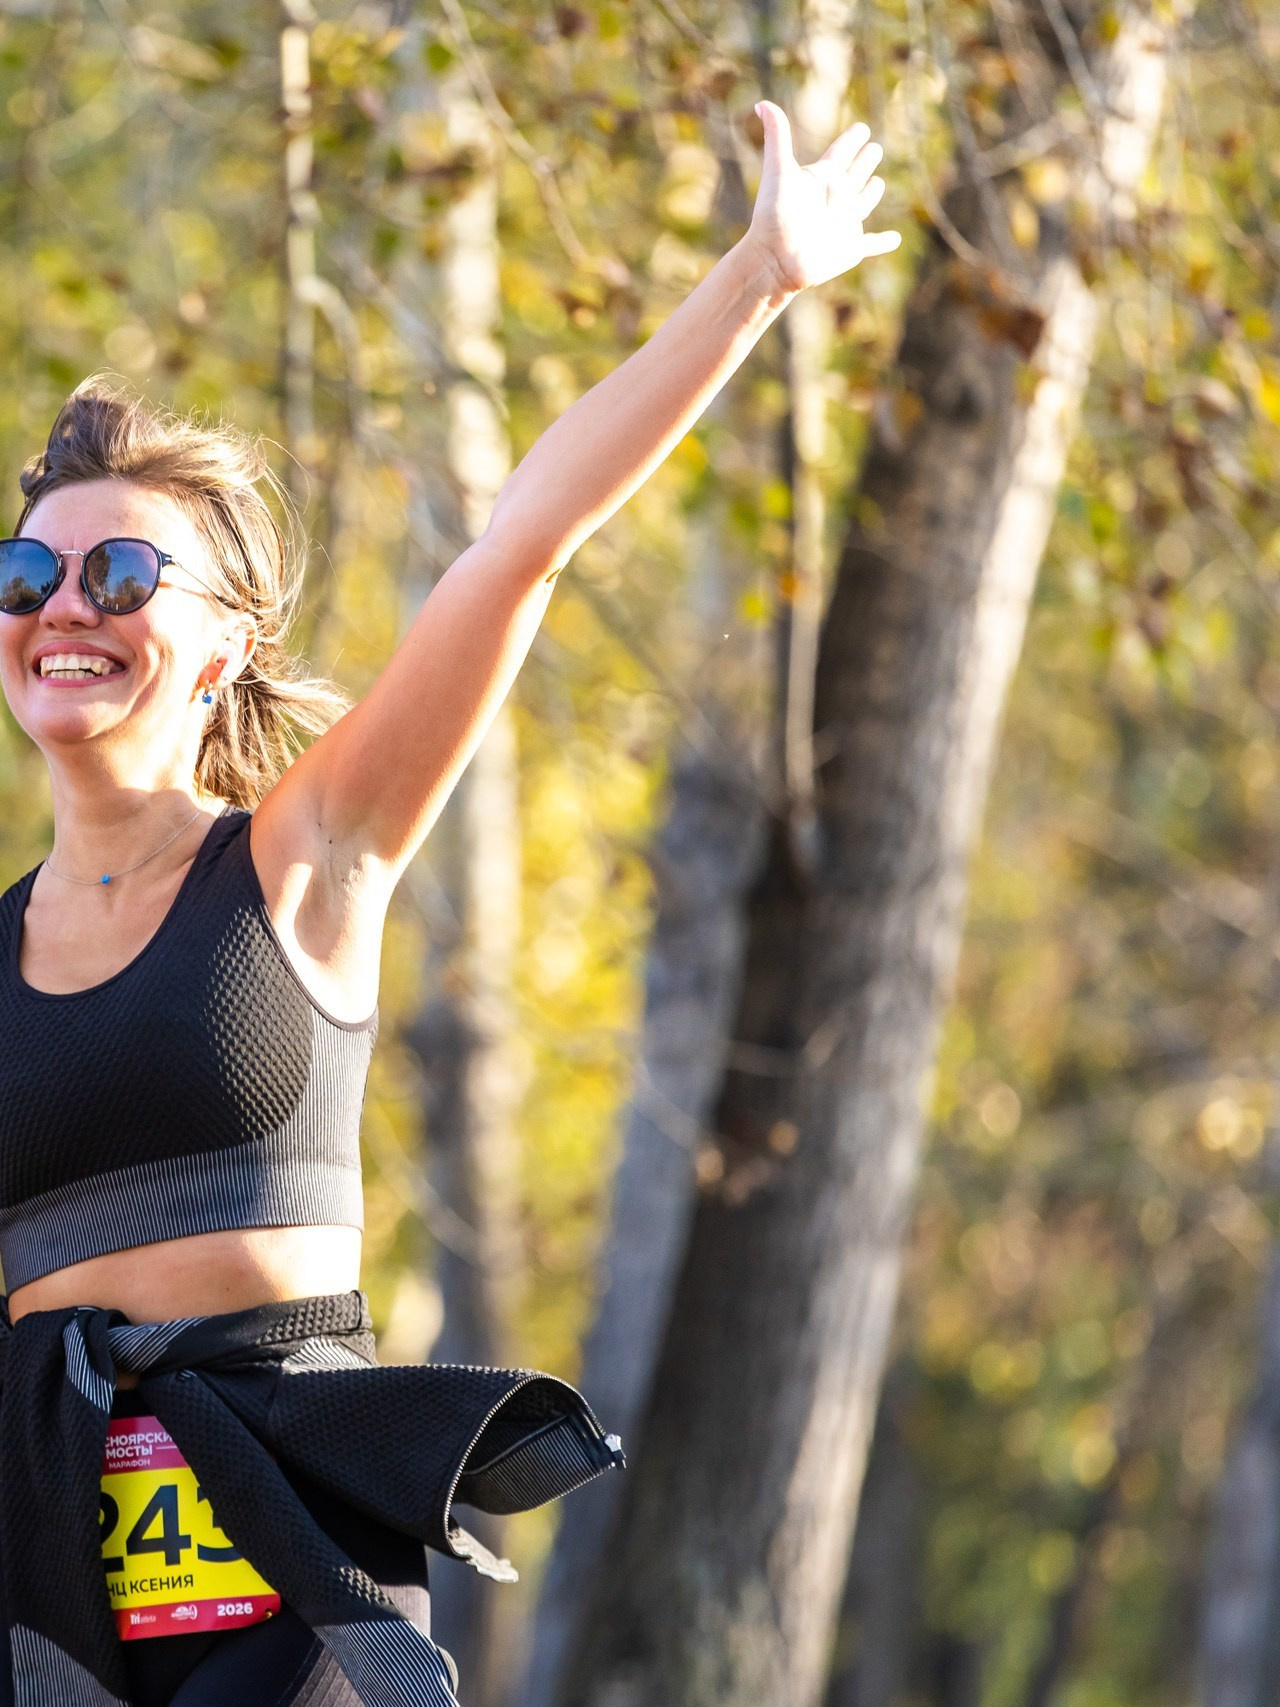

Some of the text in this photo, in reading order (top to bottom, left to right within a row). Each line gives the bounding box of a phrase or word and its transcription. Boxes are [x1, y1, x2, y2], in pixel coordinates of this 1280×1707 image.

[105, 1444, 153, 1460] МОСТЫ
[108, 1459, 151, 1470] МАРАФОН
[129, 1574, 194, 1595] КСЕНИЯ
[217, 1602, 254, 1617] 2026
